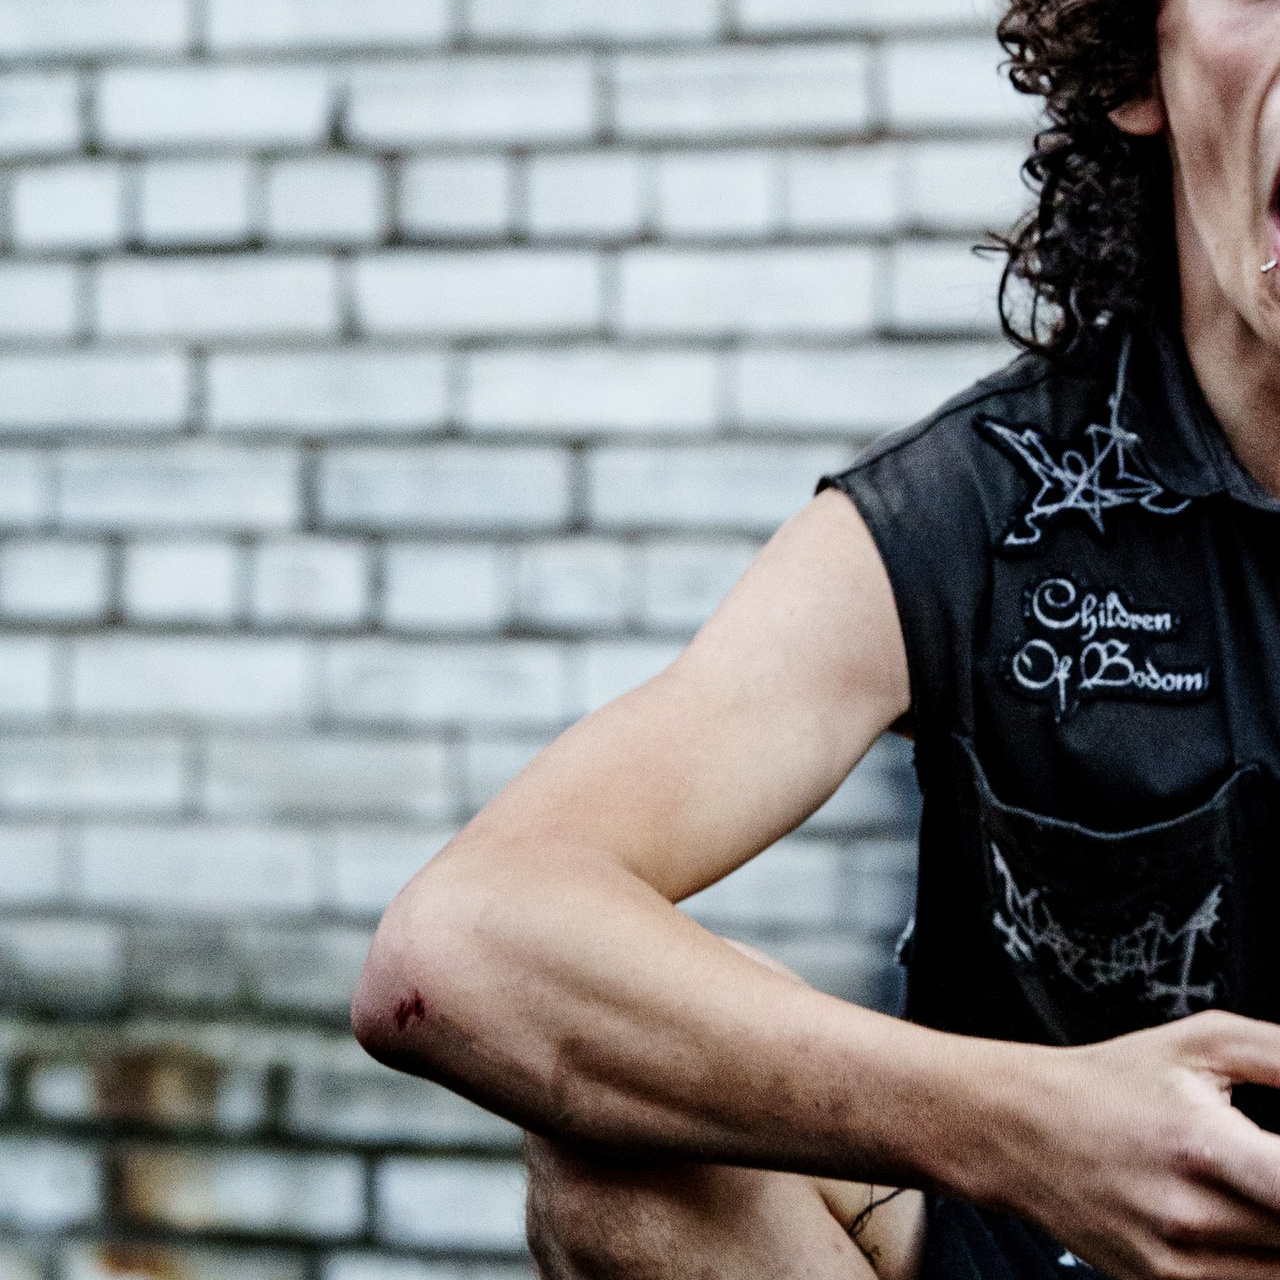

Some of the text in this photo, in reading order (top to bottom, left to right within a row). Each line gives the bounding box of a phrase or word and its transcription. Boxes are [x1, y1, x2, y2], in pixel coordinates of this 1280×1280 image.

[1032, 578, 1172, 641] Children
[1012, 638, 1204, 712] Of Bodom
